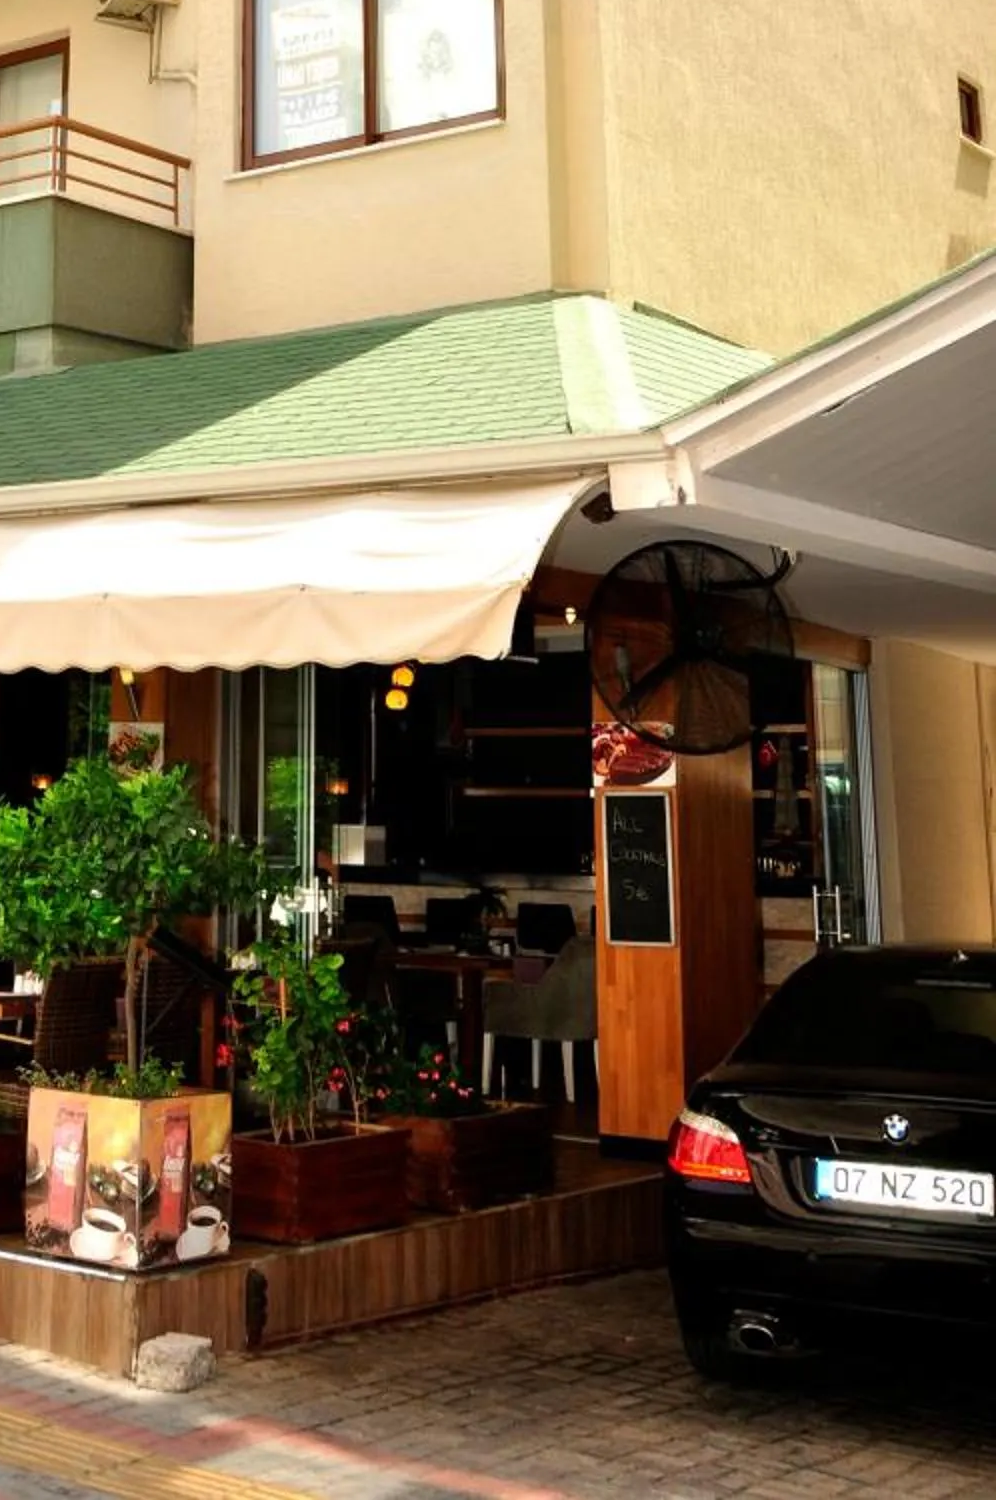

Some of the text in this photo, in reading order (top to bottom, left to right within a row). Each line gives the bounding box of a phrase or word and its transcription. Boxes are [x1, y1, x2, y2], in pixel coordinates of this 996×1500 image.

[833, 1167, 985, 1208] 07 NZ 520
